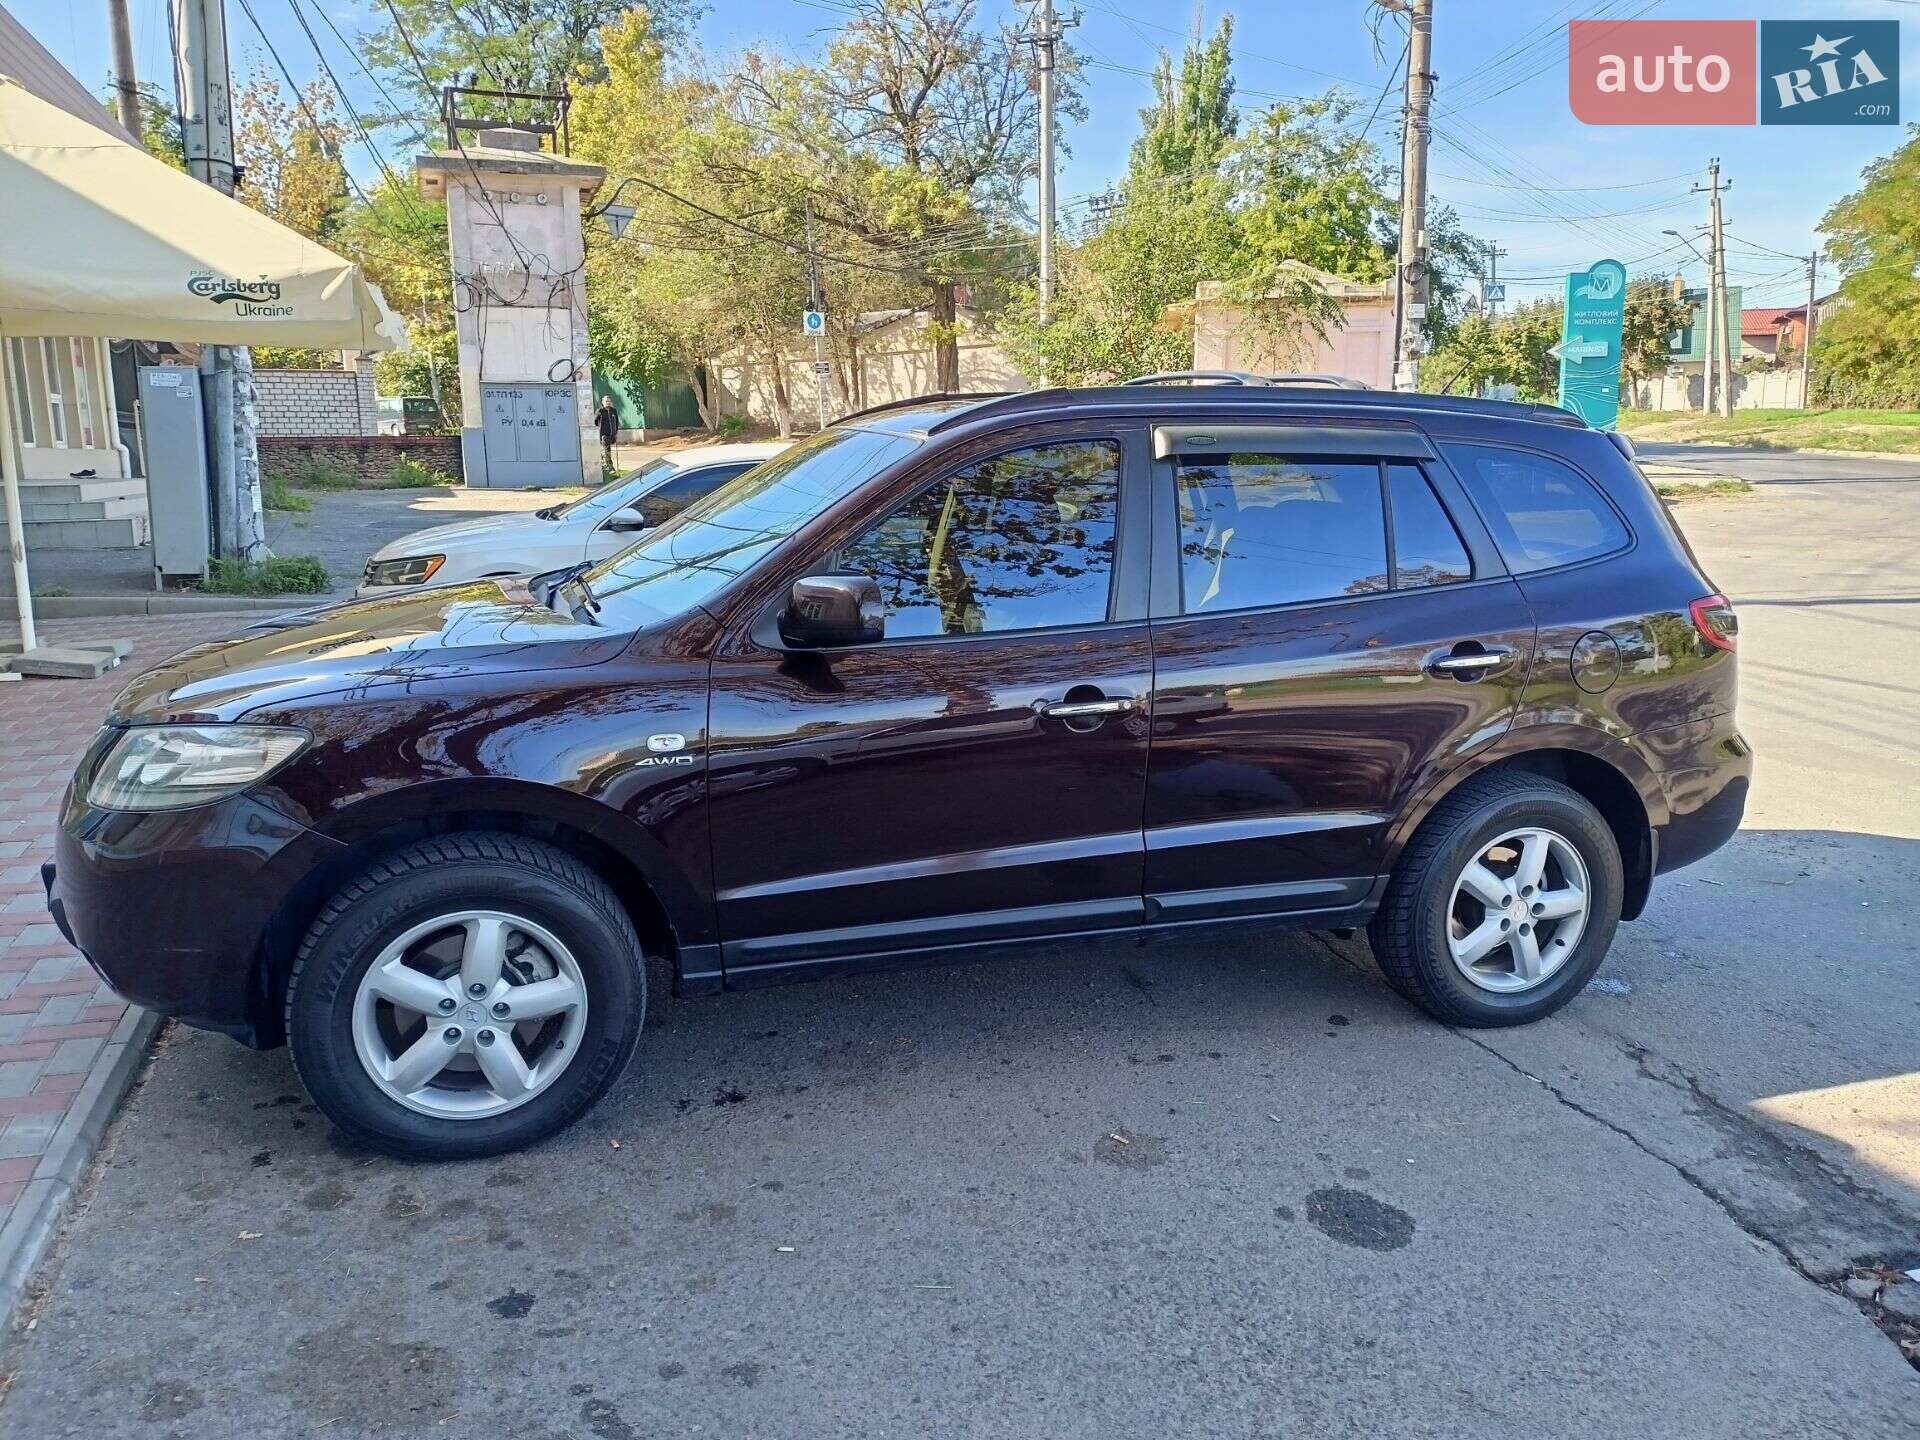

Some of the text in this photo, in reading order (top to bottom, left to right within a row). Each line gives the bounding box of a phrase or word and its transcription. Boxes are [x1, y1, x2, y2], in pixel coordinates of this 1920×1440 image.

[187, 275, 281, 301] Carlsberg
[235, 302, 294, 316] Ukraine
[1575, 310, 1618, 318] ЖИТЛОВИЙ
[635, 755, 693, 766] 4WD
